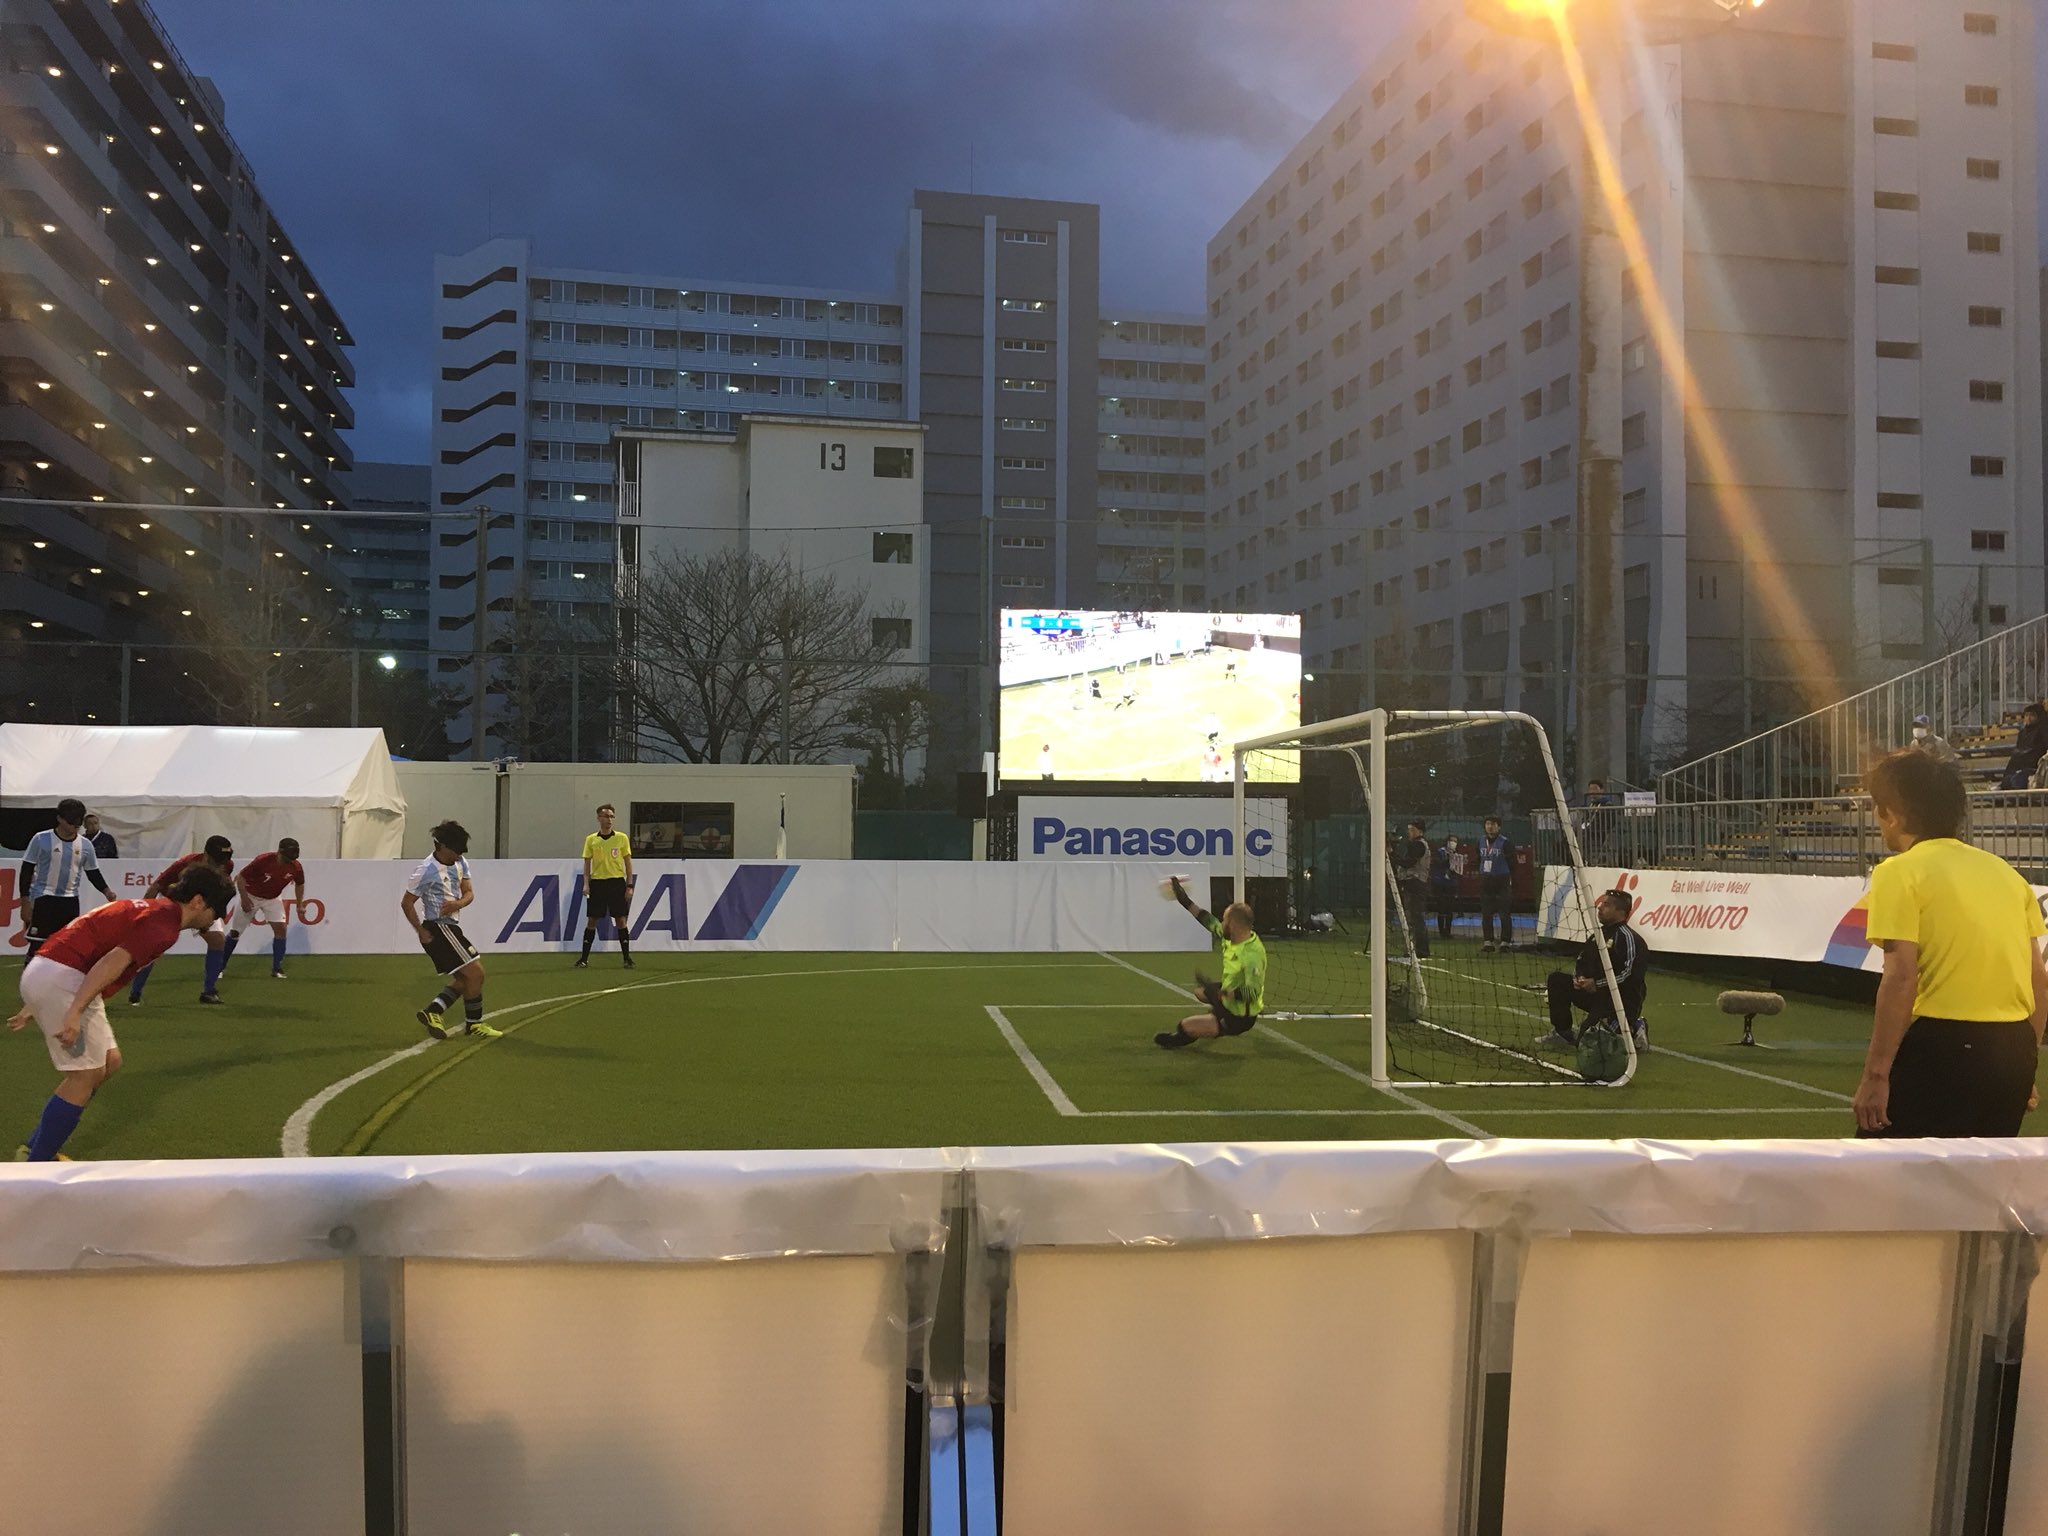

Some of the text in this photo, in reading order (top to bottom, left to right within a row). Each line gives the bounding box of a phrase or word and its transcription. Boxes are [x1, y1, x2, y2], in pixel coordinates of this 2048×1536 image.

[820, 443, 846, 471] 13
[1033, 817, 1273, 857] Panasonc
[124, 872, 153, 886] Eat
[1671, 880, 1686, 893] Eat
[1705, 881, 1725, 893] Live
[1639, 904, 1749, 931] AJINOMOTO
